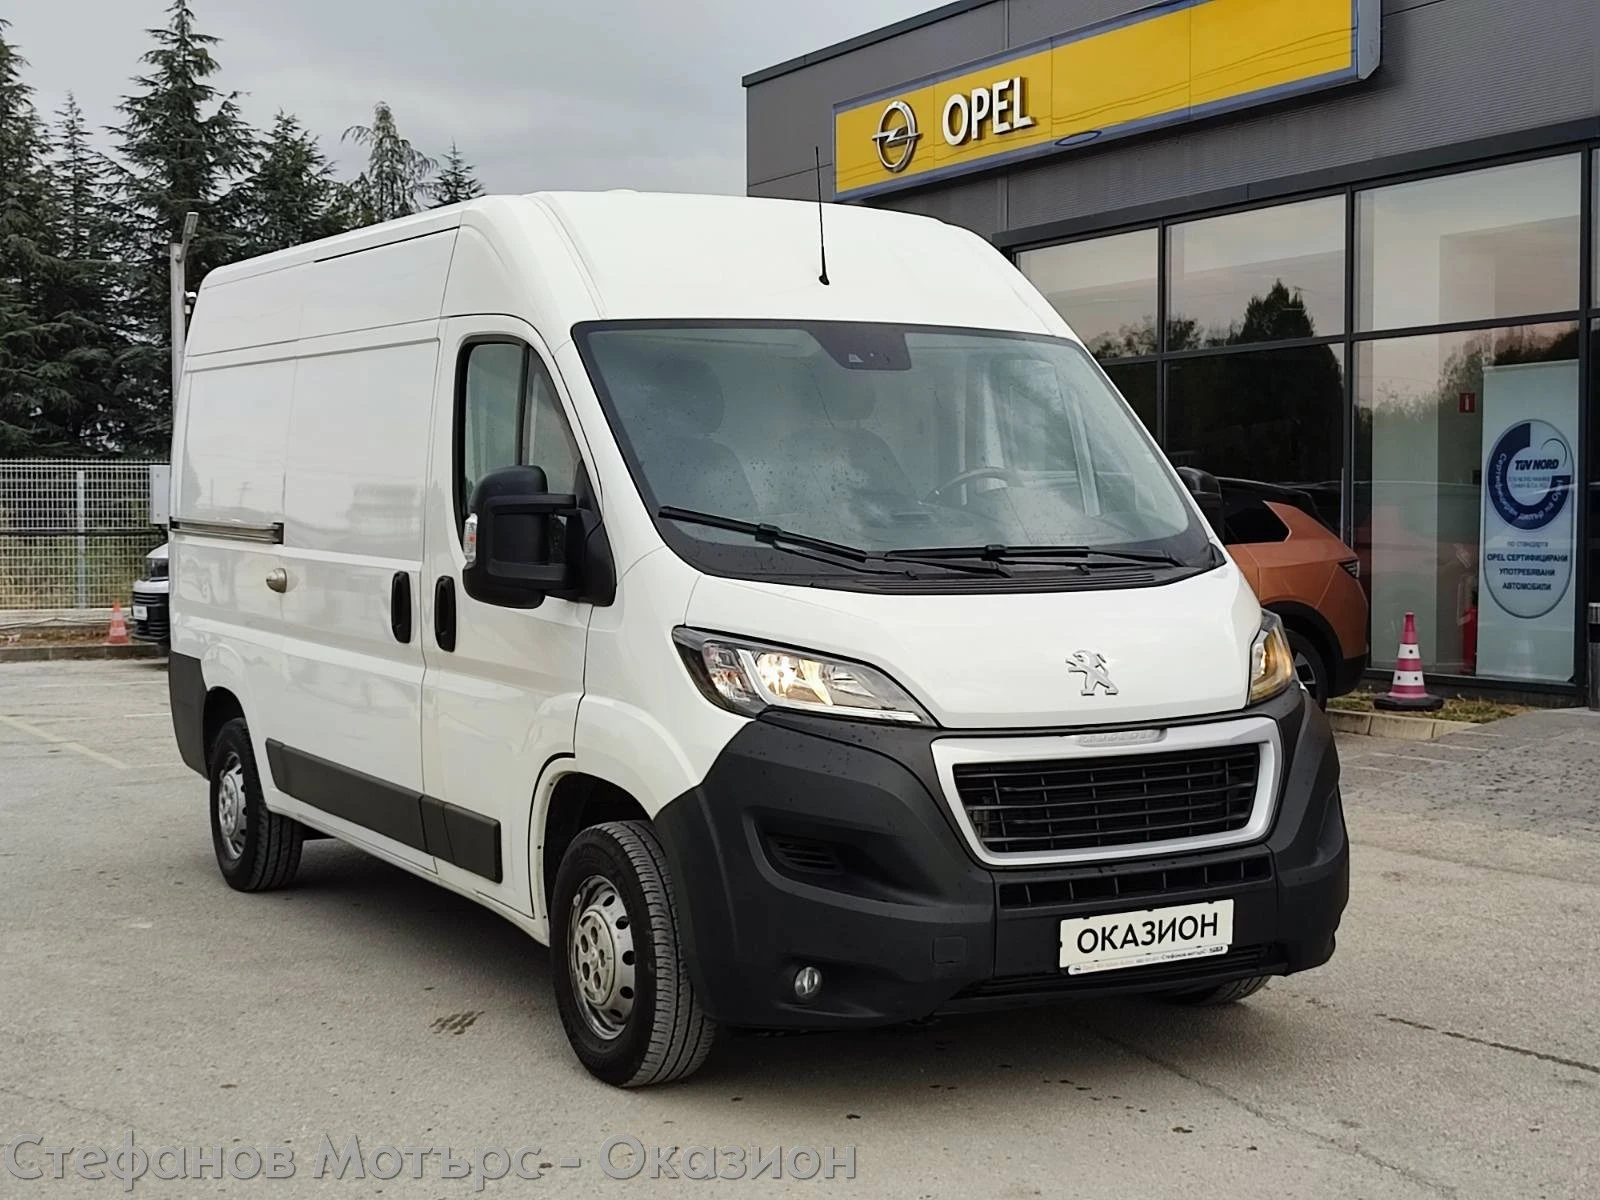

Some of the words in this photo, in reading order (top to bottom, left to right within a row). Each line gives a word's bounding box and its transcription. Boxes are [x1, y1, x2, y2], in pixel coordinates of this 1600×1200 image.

[942, 75, 1035, 146] OPEL
[1532, 458, 1559, 470] NORD
[1487, 553, 1506, 562] OPEL
[1499, 568, 1556, 577] УПОТРЕБЯВАНИ
[1502, 582, 1552, 591] АВТОМОБИЛИ
[1077, 912, 1219, 954] ОКАЗИОН
